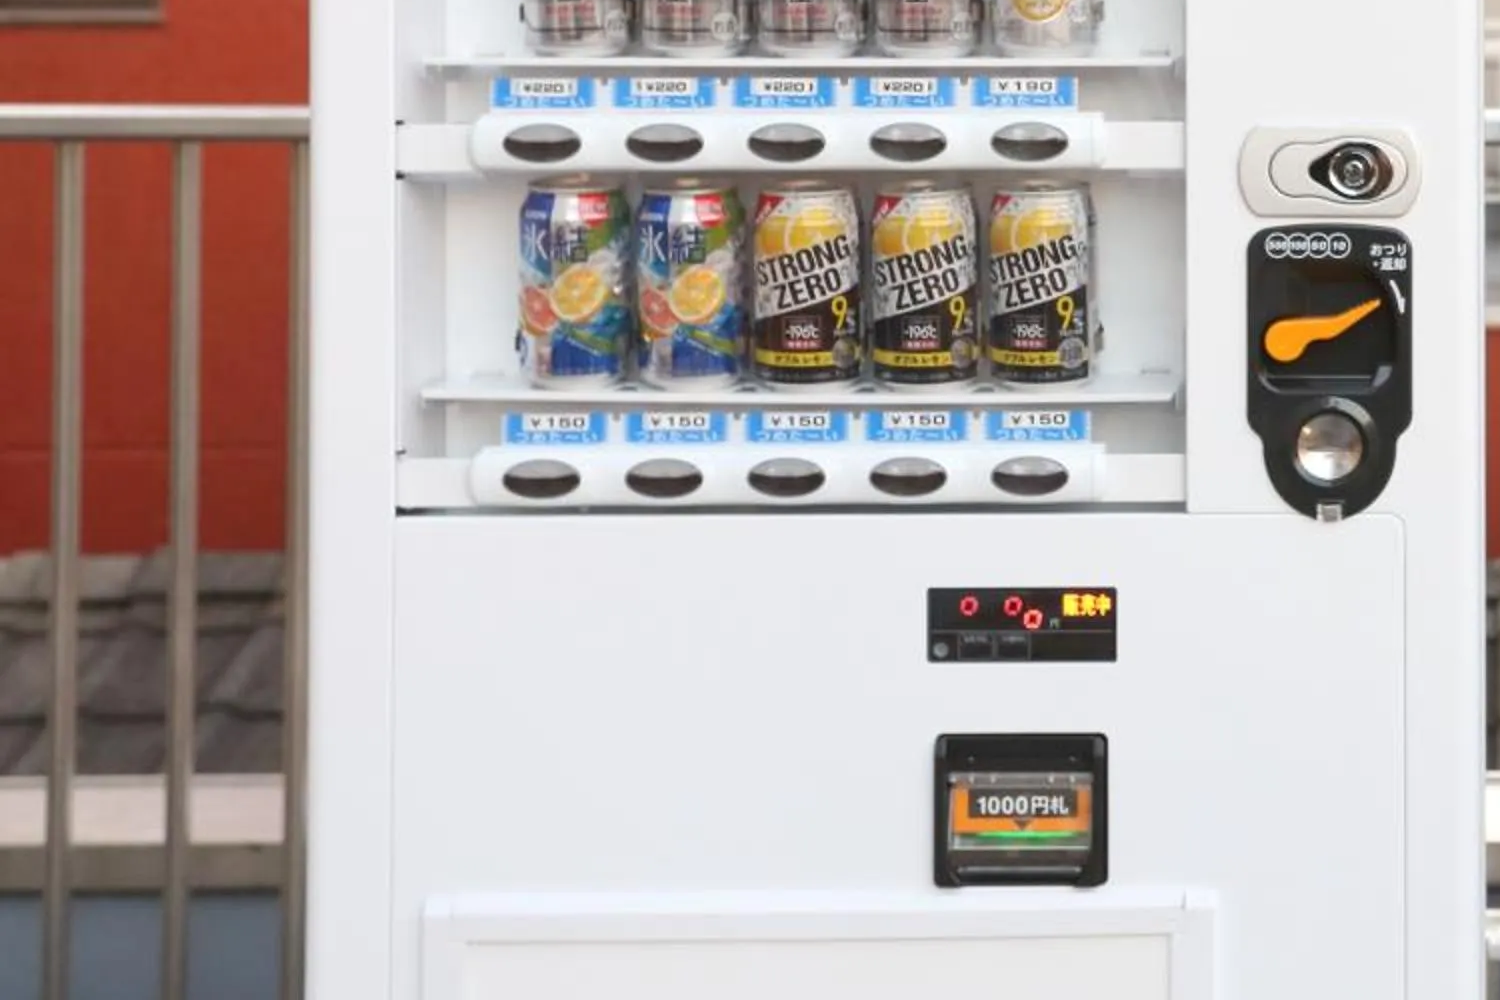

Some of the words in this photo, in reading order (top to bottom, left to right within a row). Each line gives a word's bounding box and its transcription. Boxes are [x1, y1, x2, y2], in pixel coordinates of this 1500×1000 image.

[756, 234, 850, 287] STRONG
[873, 234, 969, 287] STRONG
[989, 234, 1078, 286] STRONG
[774, 267, 842, 310] ZERO
[892, 267, 960, 311] ZERO
[1000, 266, 1068, 309] ZERO
[530, 416, 585, 429] ¥150
[650, 416, 706, 428] ¥150
[770, 414, 825, 427] ¥150
[890, 413, 946, 426] ¥150
[1010, 413, 1066, 426] ¥150
[975, 795, 1070, 817] 1000円札
